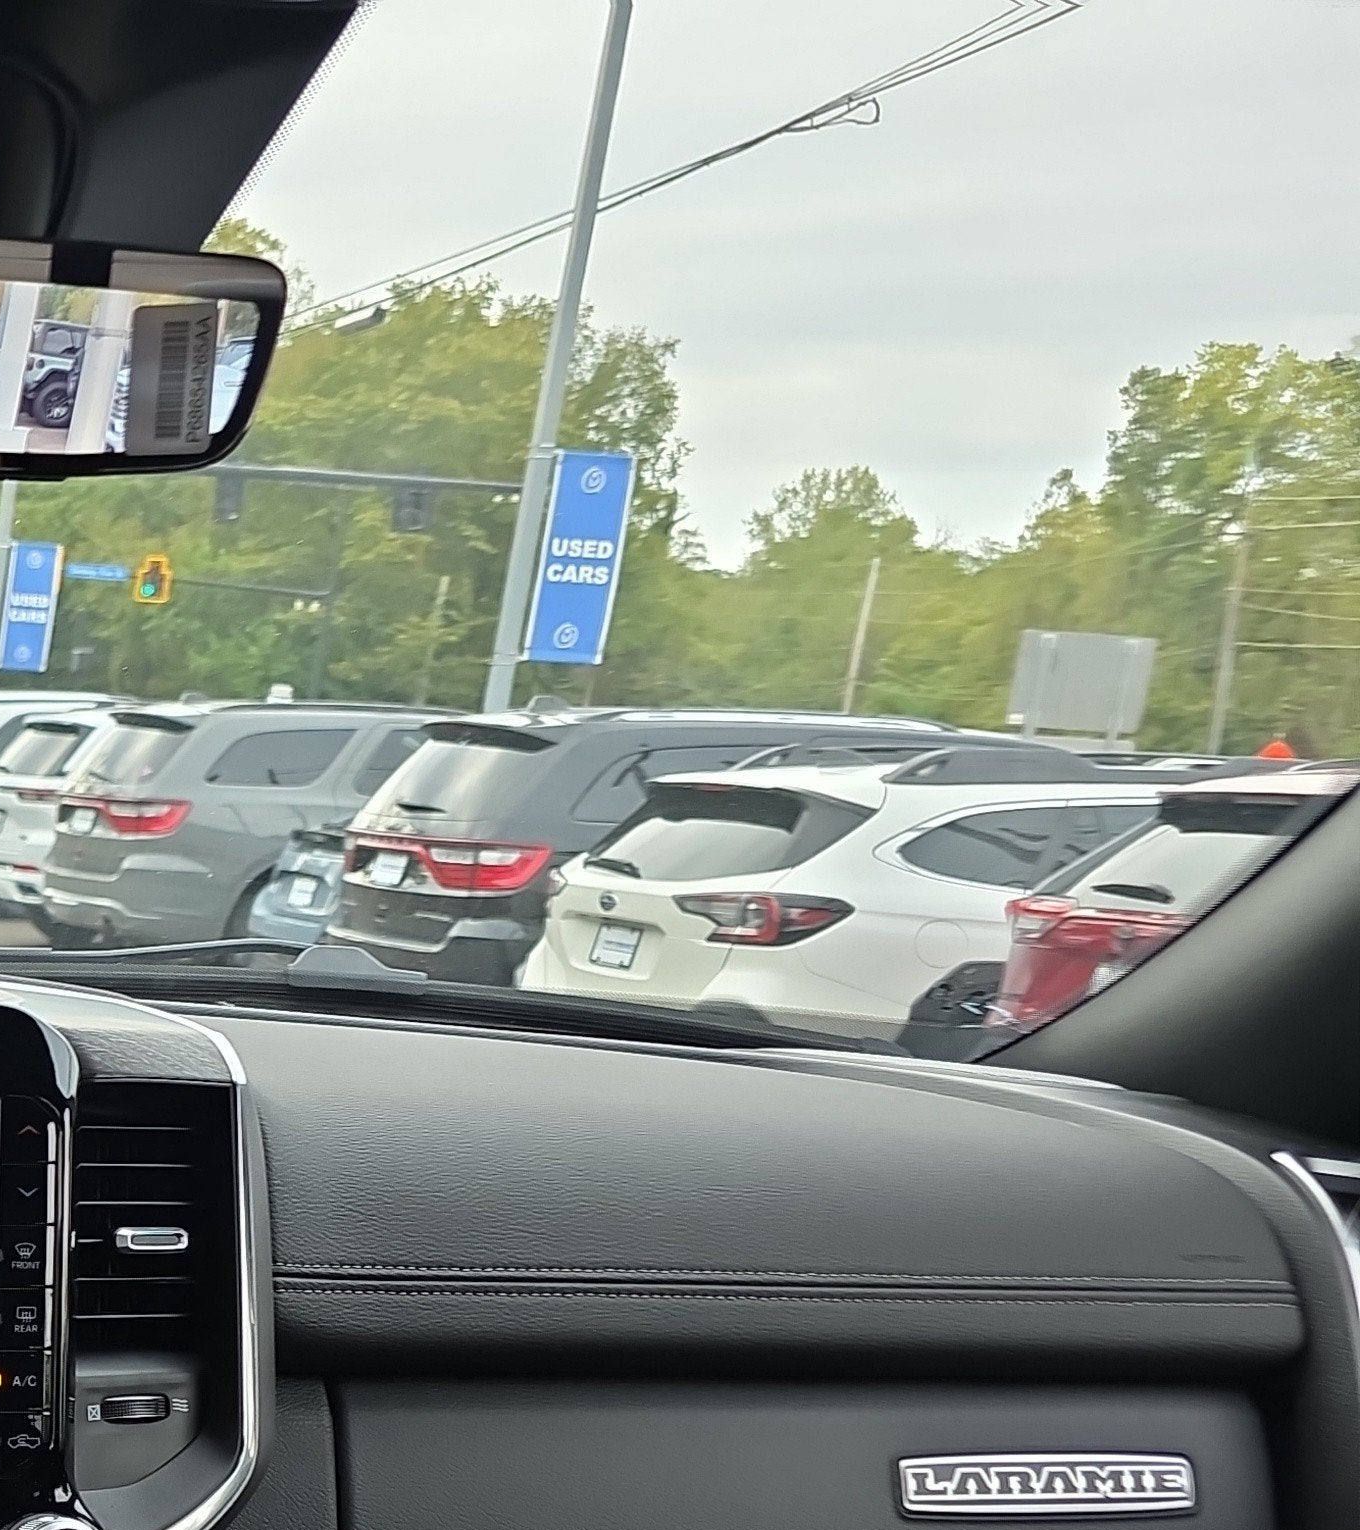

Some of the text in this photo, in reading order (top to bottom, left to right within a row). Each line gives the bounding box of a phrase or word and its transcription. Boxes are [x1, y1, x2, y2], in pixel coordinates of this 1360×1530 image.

[551, 537, 615, 560] USED
[546, 563, 610, 586] CARS
[11, 1261, 41, 1270] FRONT
[14, 1324, 38, 1333] REAR
[12, 1375, 37, 1387] A/C
[905, 1465, 1191, 1501] LARAMIE
